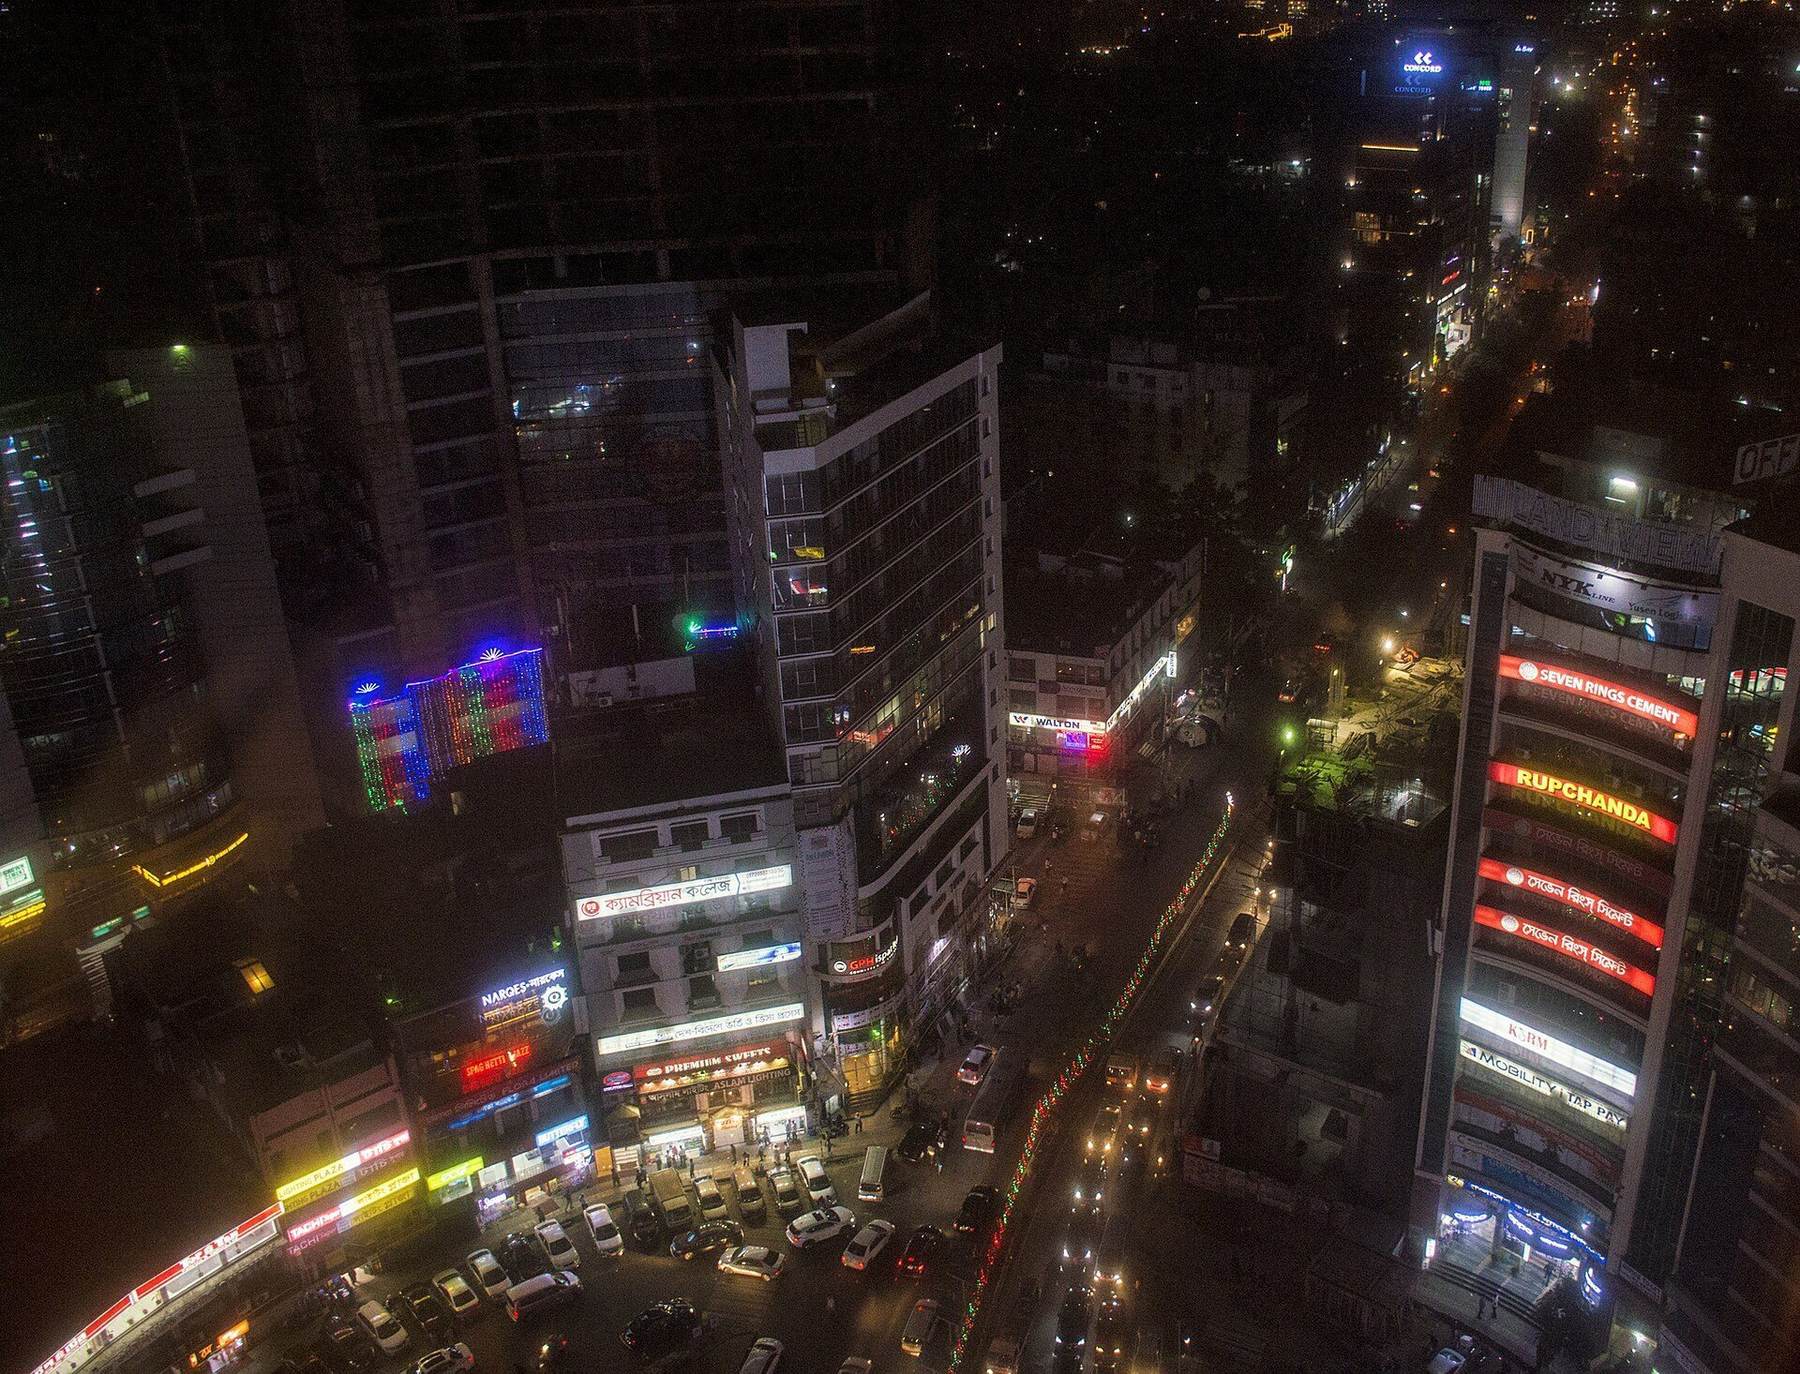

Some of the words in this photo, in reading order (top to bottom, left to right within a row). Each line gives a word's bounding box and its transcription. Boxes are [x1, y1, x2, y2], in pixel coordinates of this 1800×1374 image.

[1403, 64, 1442, 73] CONCORD
[1541, 568, 1596, 597] NYK
[1592, 592, 1616, 605] LINE
[1628, 601, 1658, 616] Yusen
[1540, 669, 1583, 692] SEVEN
[1584, 680, 1626, 705] RINGS
[1626, 694, 1680, 727] CEMENT
[1035, 717, 1080, 730] WALTON
[1516, 769, 1652, 831] RUPCHANDA
[604, 887, 682, 912] ক্যামব্রিয়ান
[685, 879, 731, 899] কলেজ
[1527, 874, 1565, 898] সেভেন
[1596, 899, 1634, 928] সিমেন্ট
[1522, 921, 1559, 946] সেভেন
[1590, 947, 1626, 977] সিমেন্ট
[848, 957, 875, 971] GPH
[664, 1056, 722, 1075] PREMIUM
[725, 1047, 771, 1064] SWEETS
[714, 1077, 747, 1091] ASLAM
[747, 1069, 792, 1085] LIGHTING
[1480, 1049, 1559, 1096] MOBILITY
[1566, 1092, 1593, 1112] TAP
[1596, 1105, 1626, 1127] PAY
[313, 1163, 344, 1182] PLAZA
[290, 1218, 322, 1240] TACHI
